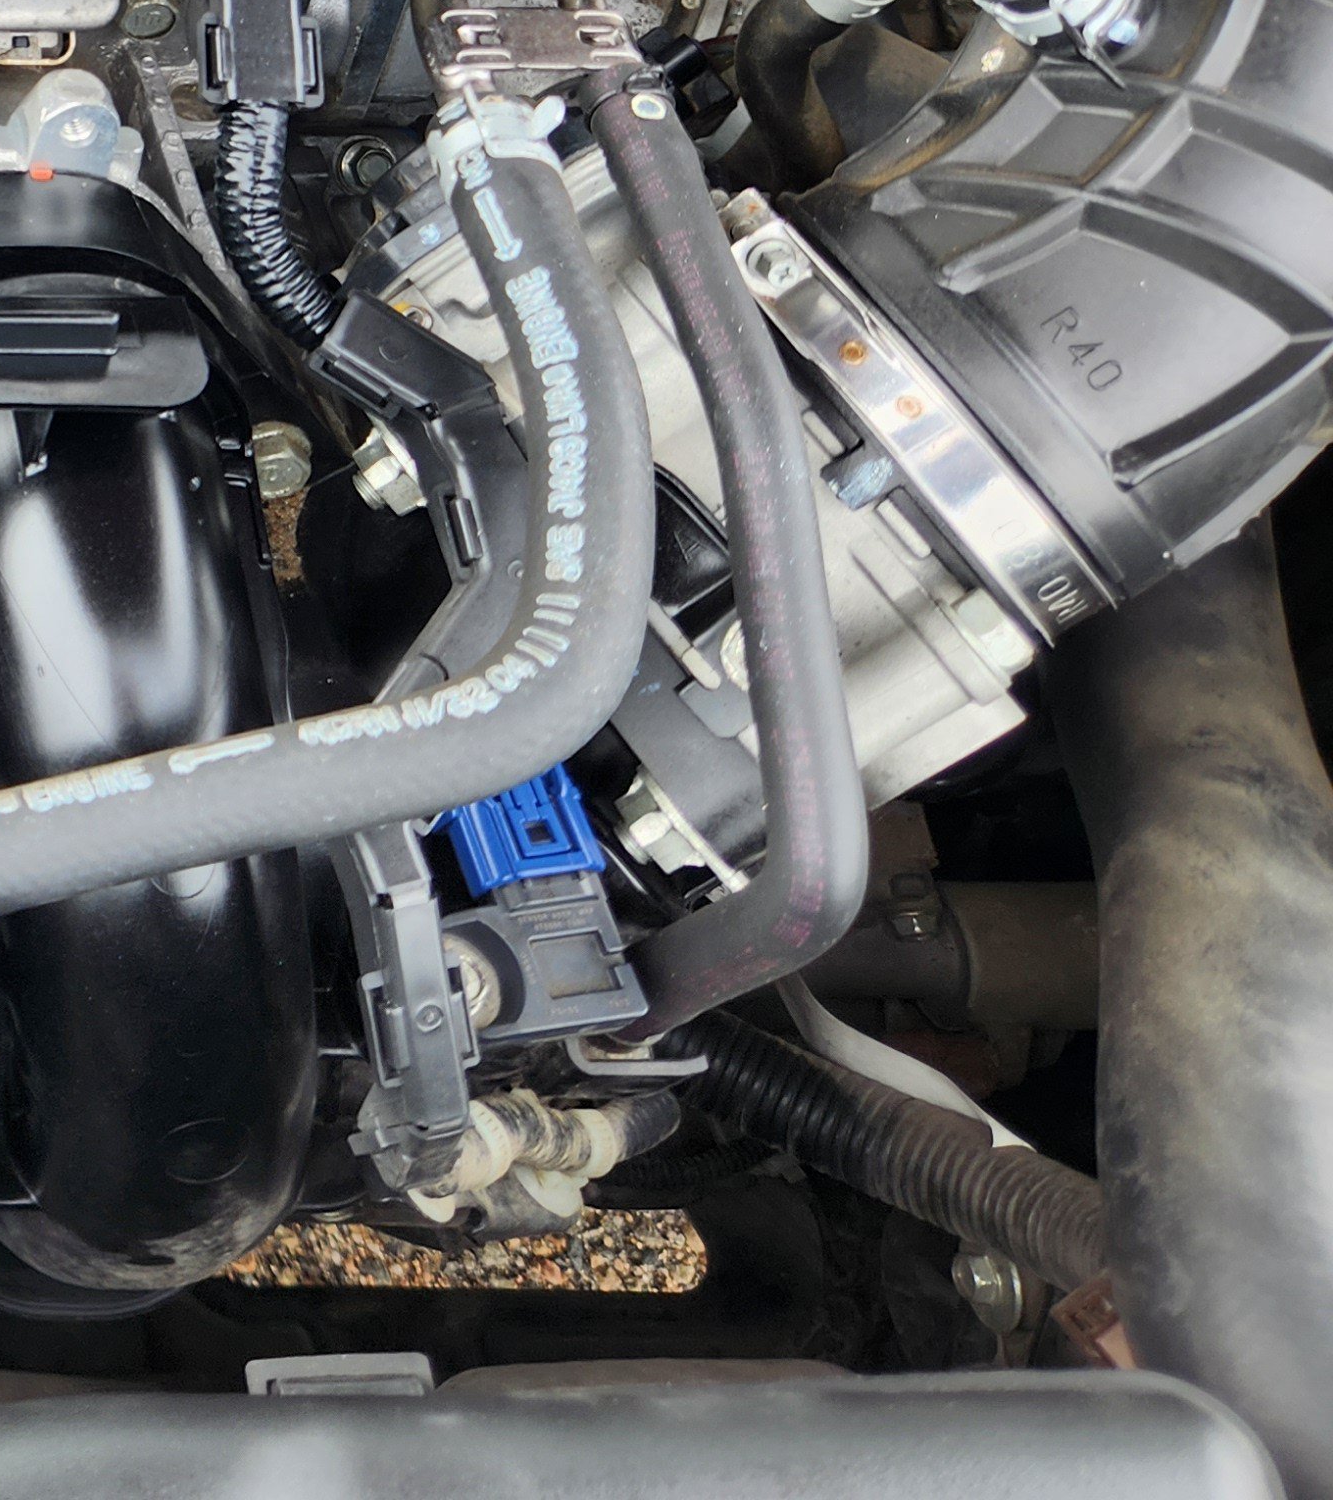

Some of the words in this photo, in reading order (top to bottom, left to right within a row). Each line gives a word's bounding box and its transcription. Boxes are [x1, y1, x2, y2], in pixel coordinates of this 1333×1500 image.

[504, 264, 580, 371] ENGINE
[1039, 305, 1123, 392] R40
[547, 433, 590, 520] J1403
[544, 522, 586, 583] SAE
[23, 764, 155, 813] ENGINE
